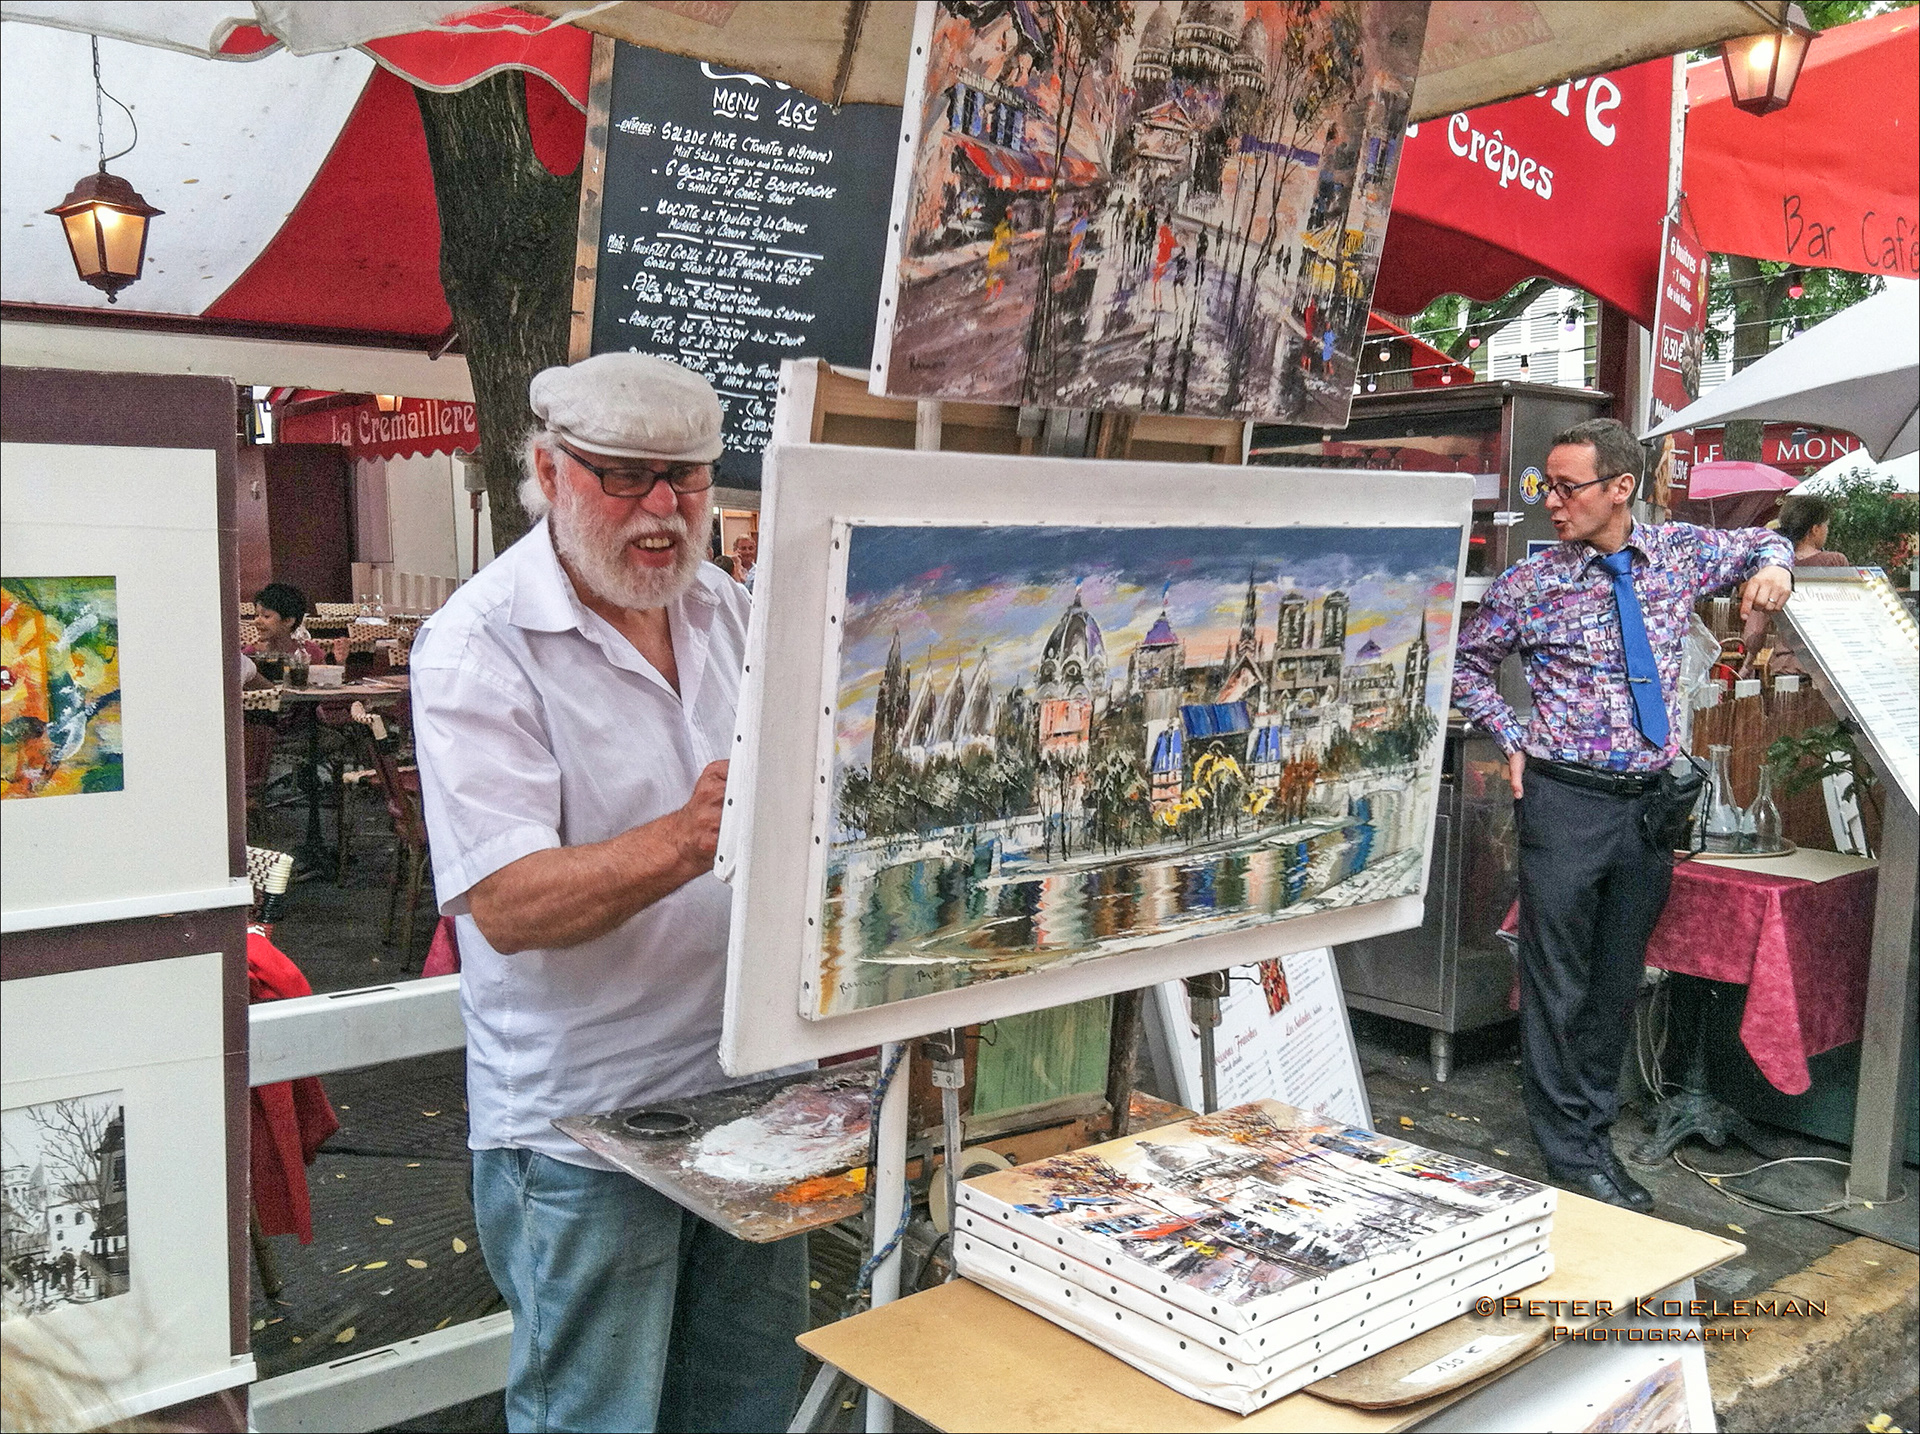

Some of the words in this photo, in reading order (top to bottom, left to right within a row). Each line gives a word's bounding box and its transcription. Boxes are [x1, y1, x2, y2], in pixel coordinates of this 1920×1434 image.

[713, 86, 759, 113] MENU
[1448, 112, 1554, 200] Crêpes
[665, 159, 678, 176] 6
[745, 175, 762, 189] DE
[764, 176, 837, 199] BOURGOGNE
[676, 177, 687, 190] 6
[1670, 236, 1676, 256] 6
[1783, 195, 1836, 260] Bar
[1861, 211, 1919, 273] Café
[664, 282, 685, 299] AUX
[703, 285, 761, 307] SAUMONS
[679, 336, 697, 347] OF
[714, 339, 739, 352] DAY
[680, 320, 697, 334] DE
[699, 320, 750, 340] POISSON
[751, 329, 768, 343] DU
[769, 332, 806, 347] JOUR
[741, 419, 773, 432] CARAM
[1777, 437, 1864, 461] MON
